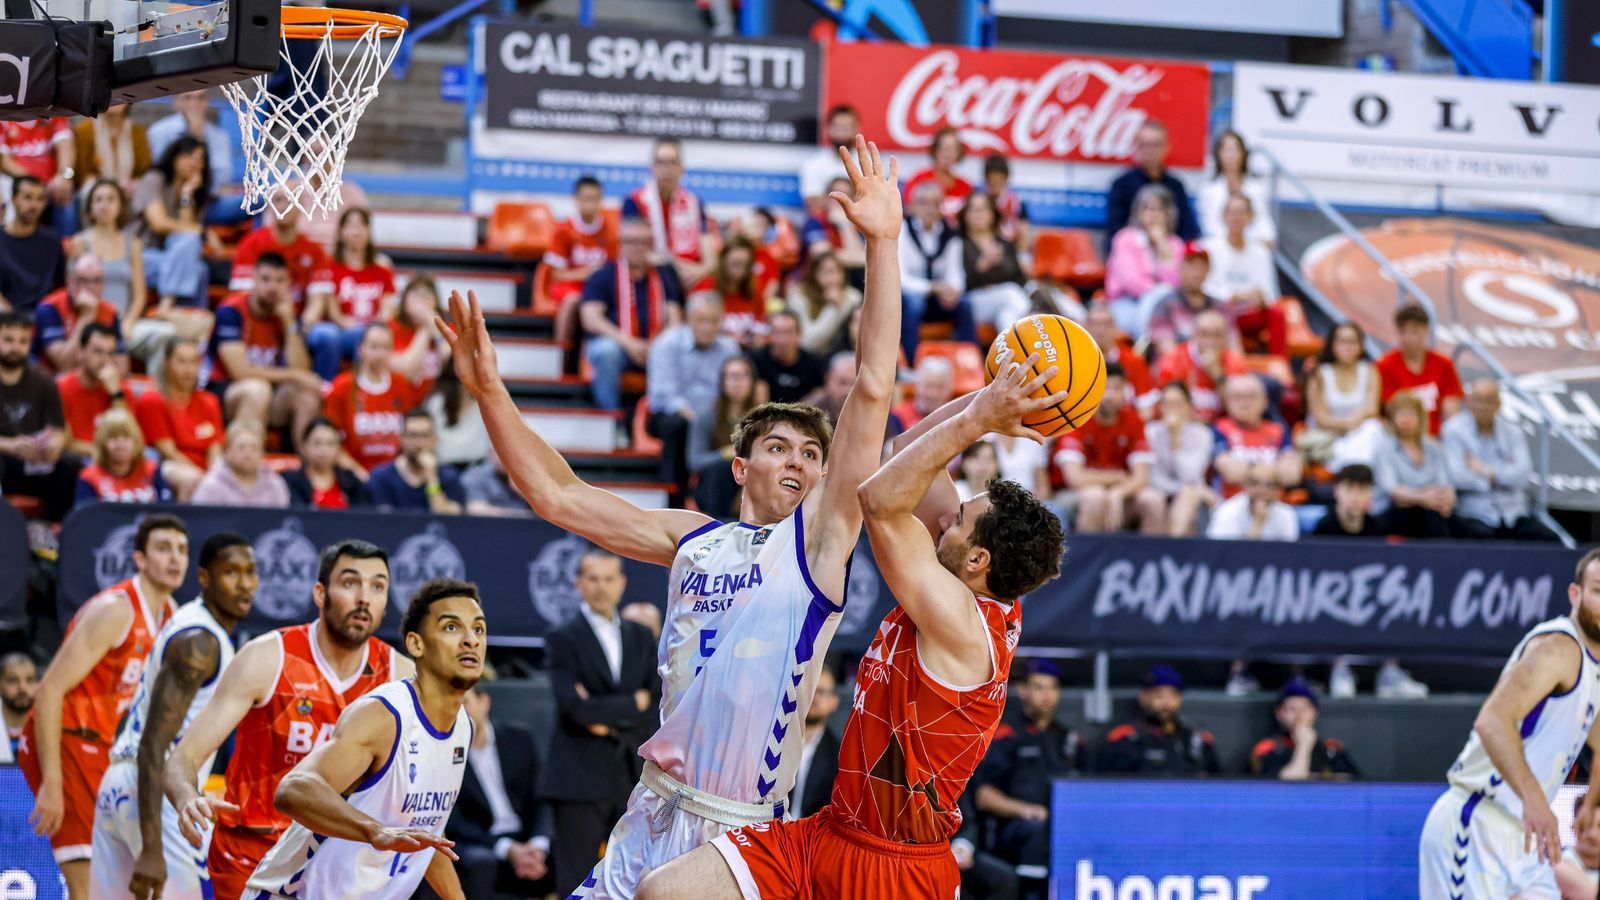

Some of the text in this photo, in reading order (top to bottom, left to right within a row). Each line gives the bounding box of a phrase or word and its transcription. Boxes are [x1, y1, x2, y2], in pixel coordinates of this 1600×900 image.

[500, 31, 805, 89] CAL SPAGUETTI
[886, 50, 1165, 159] Coca-Cola
[1263, 86, 1600, 138] VOLV
[1094, 555, 1553, 631] BAXIMANRESA.COM
[408, 815, 443, 828] BASKET
